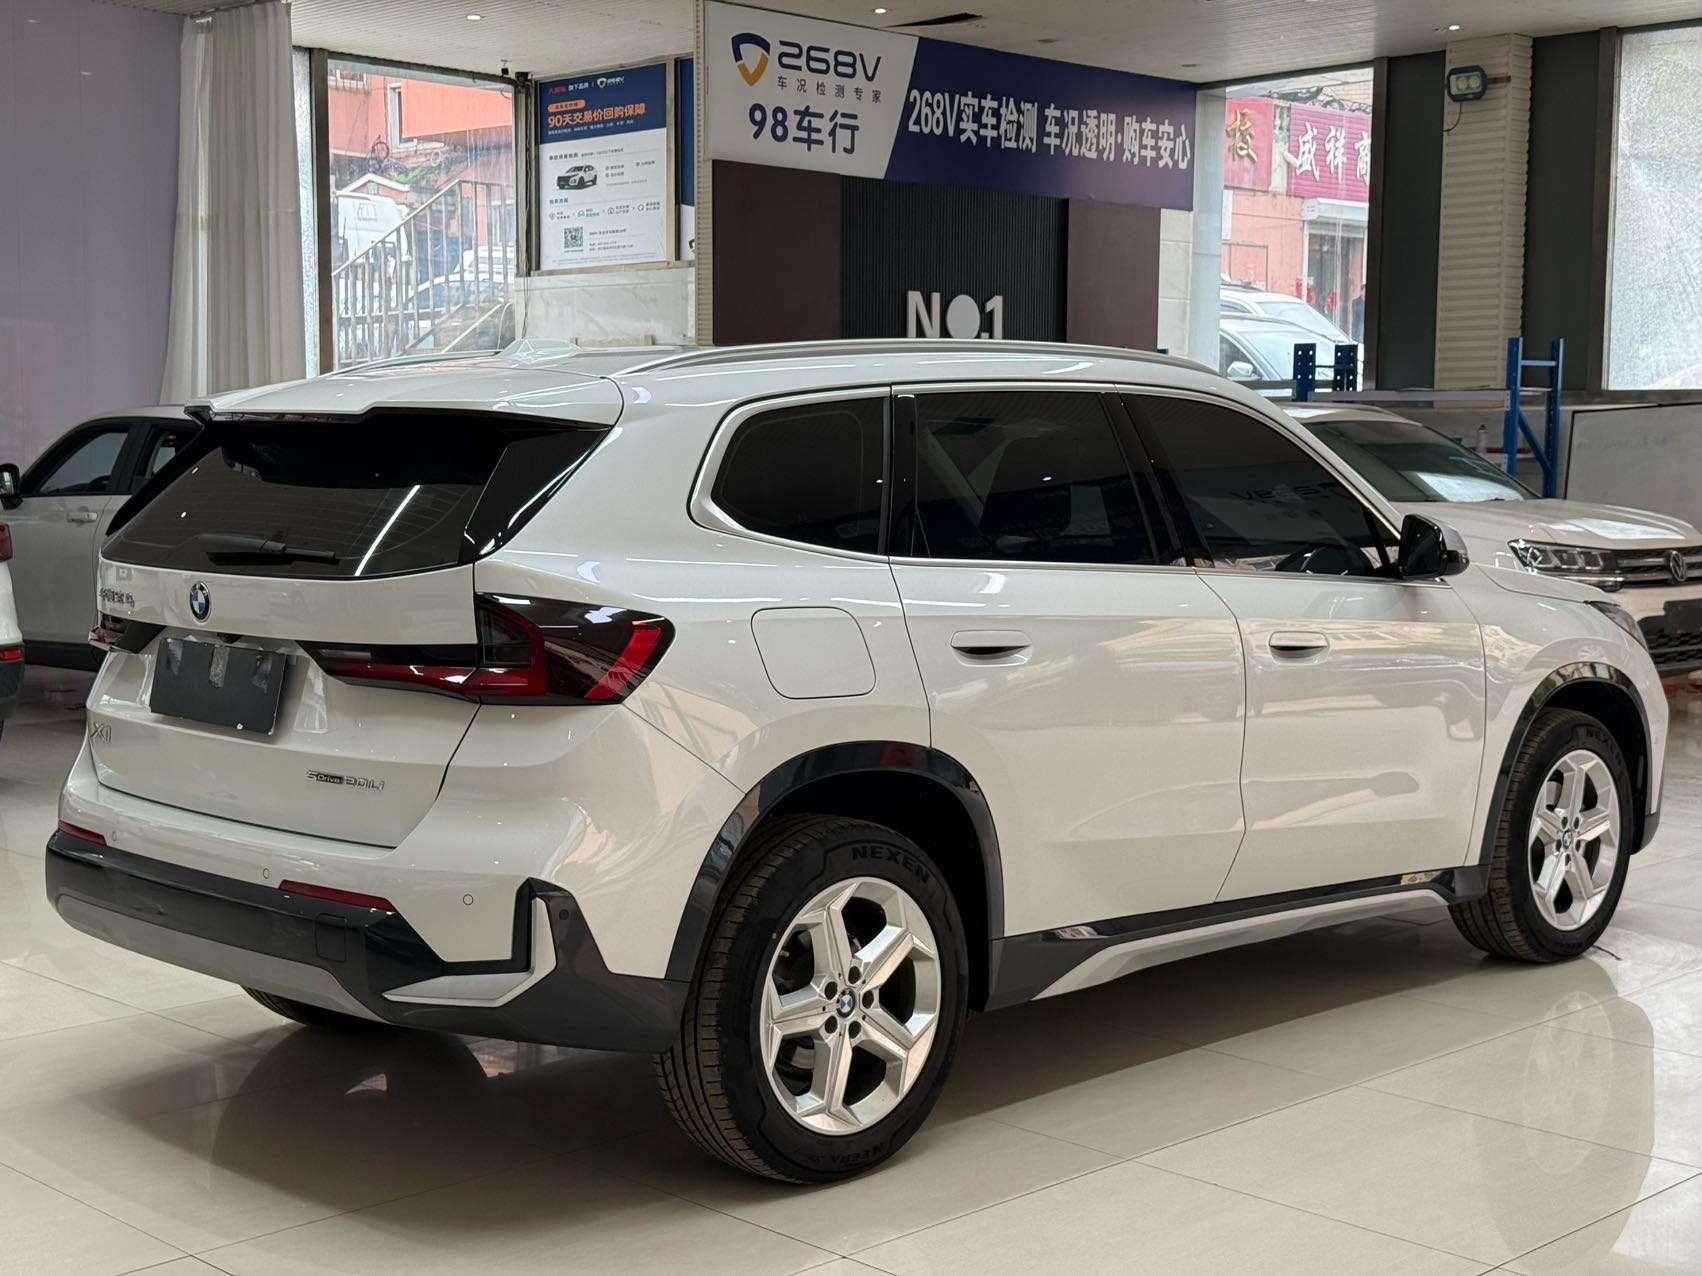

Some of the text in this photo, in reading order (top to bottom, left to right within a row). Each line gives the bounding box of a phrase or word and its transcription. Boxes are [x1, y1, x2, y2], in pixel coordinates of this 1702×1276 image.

[778, 40, 882, 82] 268V
[777, 75, 882, 104] 车况检测专家
[547, 103, 647, 128] 90天交易价回购保障
[749, 102, 860, 155] 98车行
[908, 89, 1191, 170] 268V实车检测 车况透明·购车安心
[852, 845, 929, 882] NEXEN
